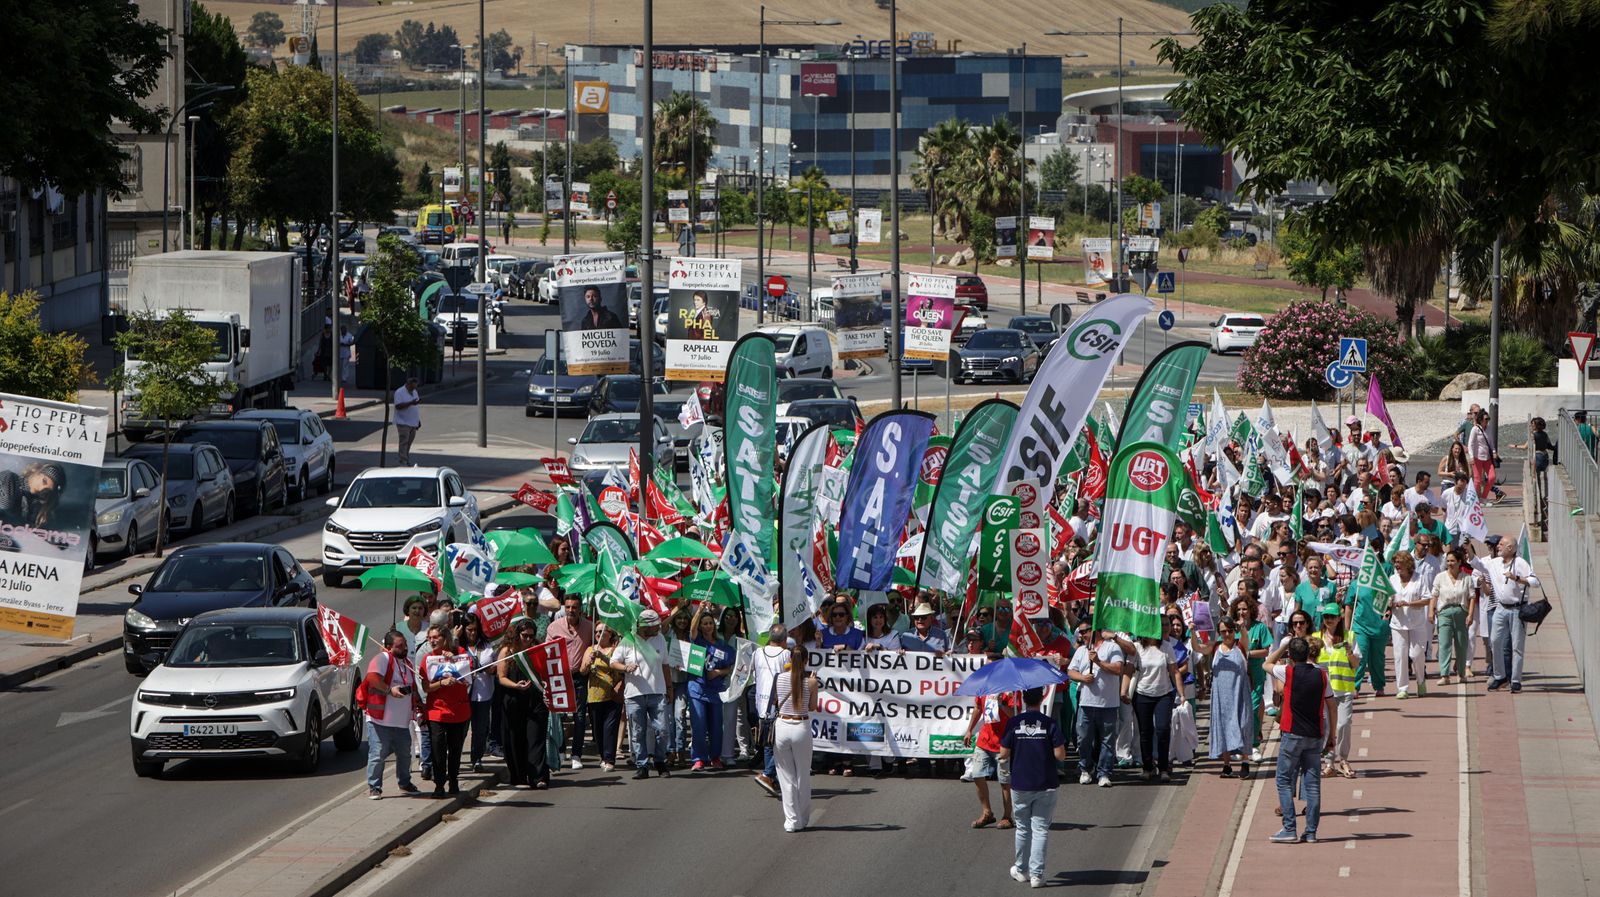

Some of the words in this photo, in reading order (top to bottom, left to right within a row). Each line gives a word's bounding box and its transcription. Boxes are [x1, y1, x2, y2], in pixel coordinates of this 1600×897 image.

[688, 271, 739, 279] FESTIVAL
[912, 310, 945, 320] QUEEN
[684, 319, 713, 330] PHA
[581, 331, 616, 340] MIGUEL
[703, 329, 719, 340] EL
[1079, 329, 1120, 354] CSIF
[581, 339, 617, 349] POVEDA
[683, 344, 720, 353] RAPHAEL
[14, 404, 42, 420] TIO
[49, 410, 89, 426] PEPE
[10, 419, 102, 443] FESTIVAL
[1134, 456, 1165, 476] UGT
[604, 490, 624, 501] UGT
[939, 442, 996, 551] SATSE
[991, 504, 1016, 518] CSIF
[1110, 522, 1166, 558] UGT
[990, 528, 1007, 588] CSIF
[12, 561, 59, 581] MENA
[8, 579, 32, 592] Julio
[24, 599, 41, 609] Byass
[46, 602, 64, 612] Jerez
[808, 651, 905, 671] DEFENSA
[915, 654, 944, 672] DE
[544, 643, 569, 709] CCOO
[848, 698, 899, 718] MÁS
[189, 724, 215, 735] 6422
[216, 724, 236, 735] LVJ
